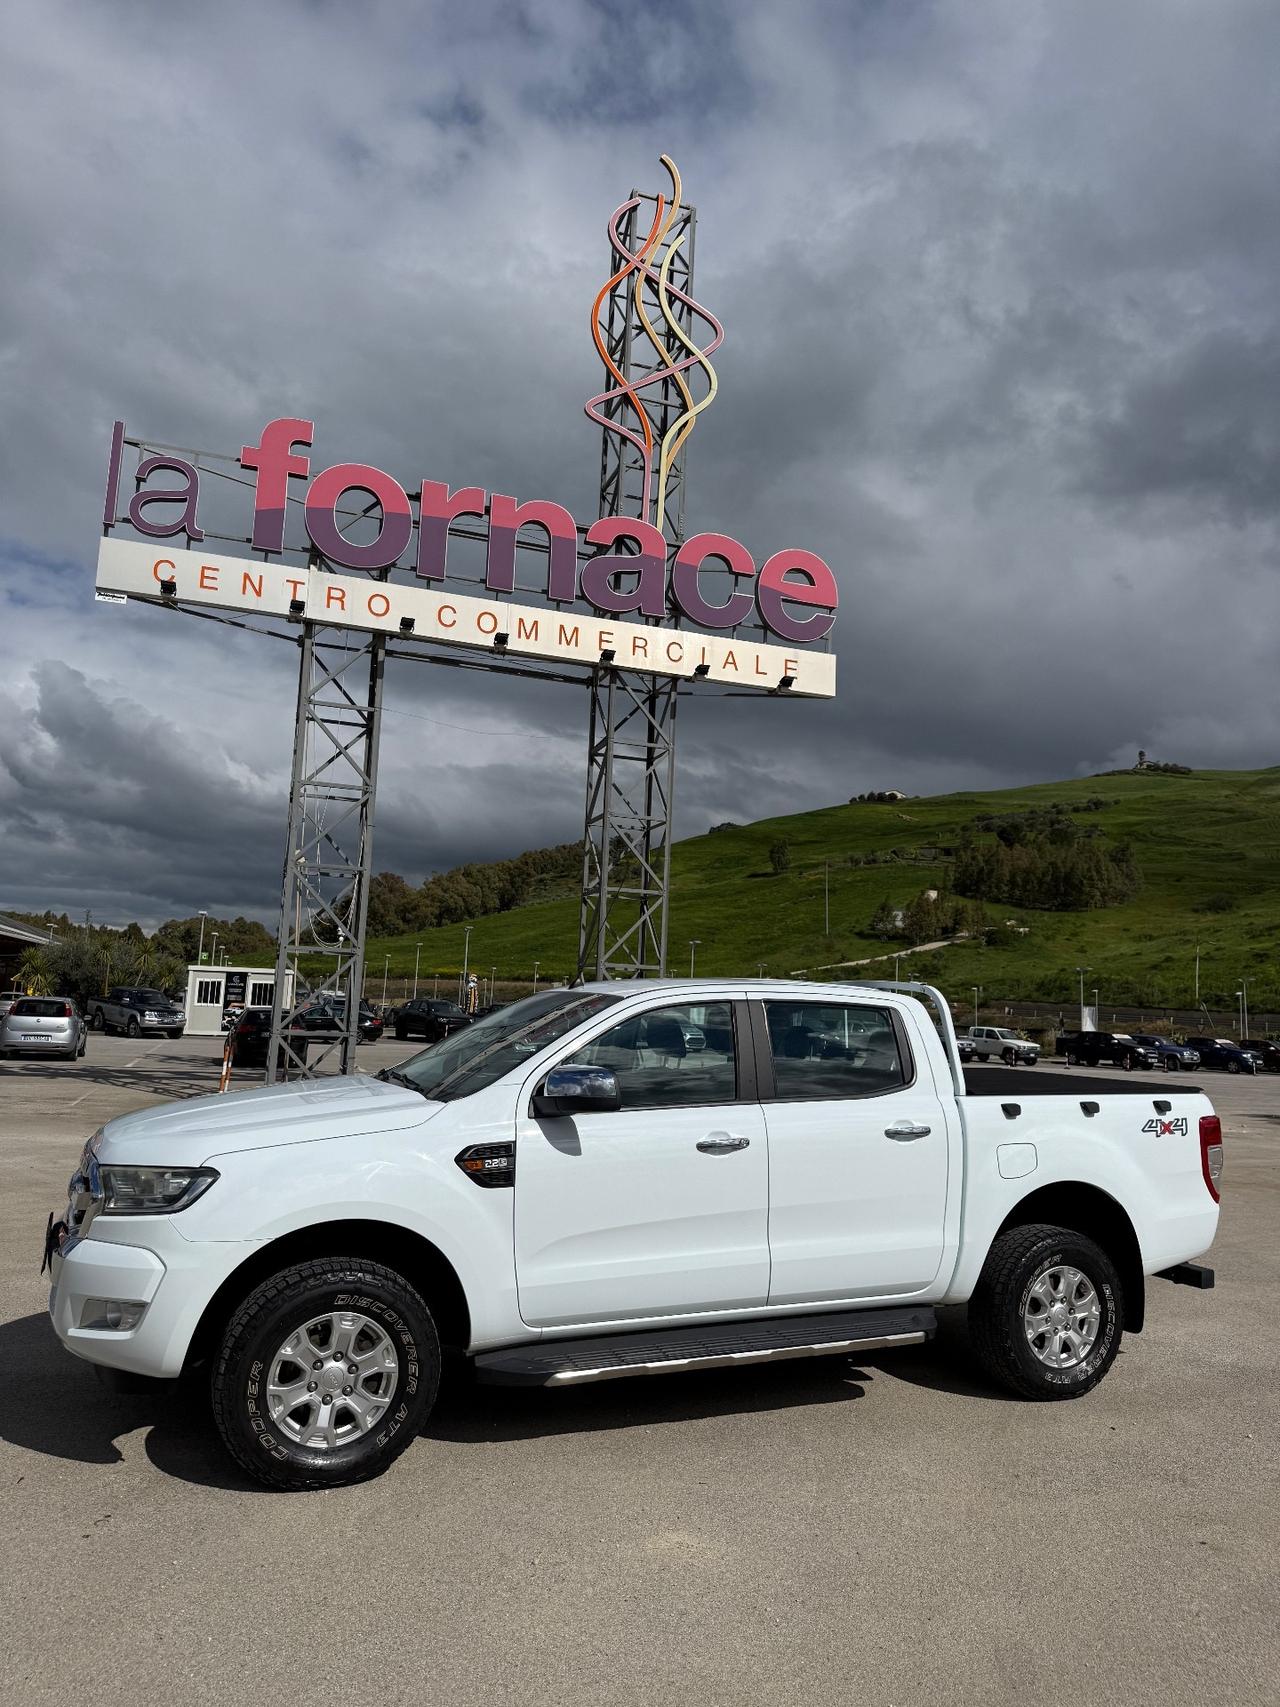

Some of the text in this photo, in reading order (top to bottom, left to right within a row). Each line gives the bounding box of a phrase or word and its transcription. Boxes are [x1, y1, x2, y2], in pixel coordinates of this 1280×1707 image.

[103, 417, 839, 643] la fornace
[152, 558, 798, 679] CENTRO COMMERCIALE
[1141, 1117, 1188, 1138] 4x4
[333, 1294, 420, 1396] DISCOVERER
[247, 1360, 289, 1461] COOPER
